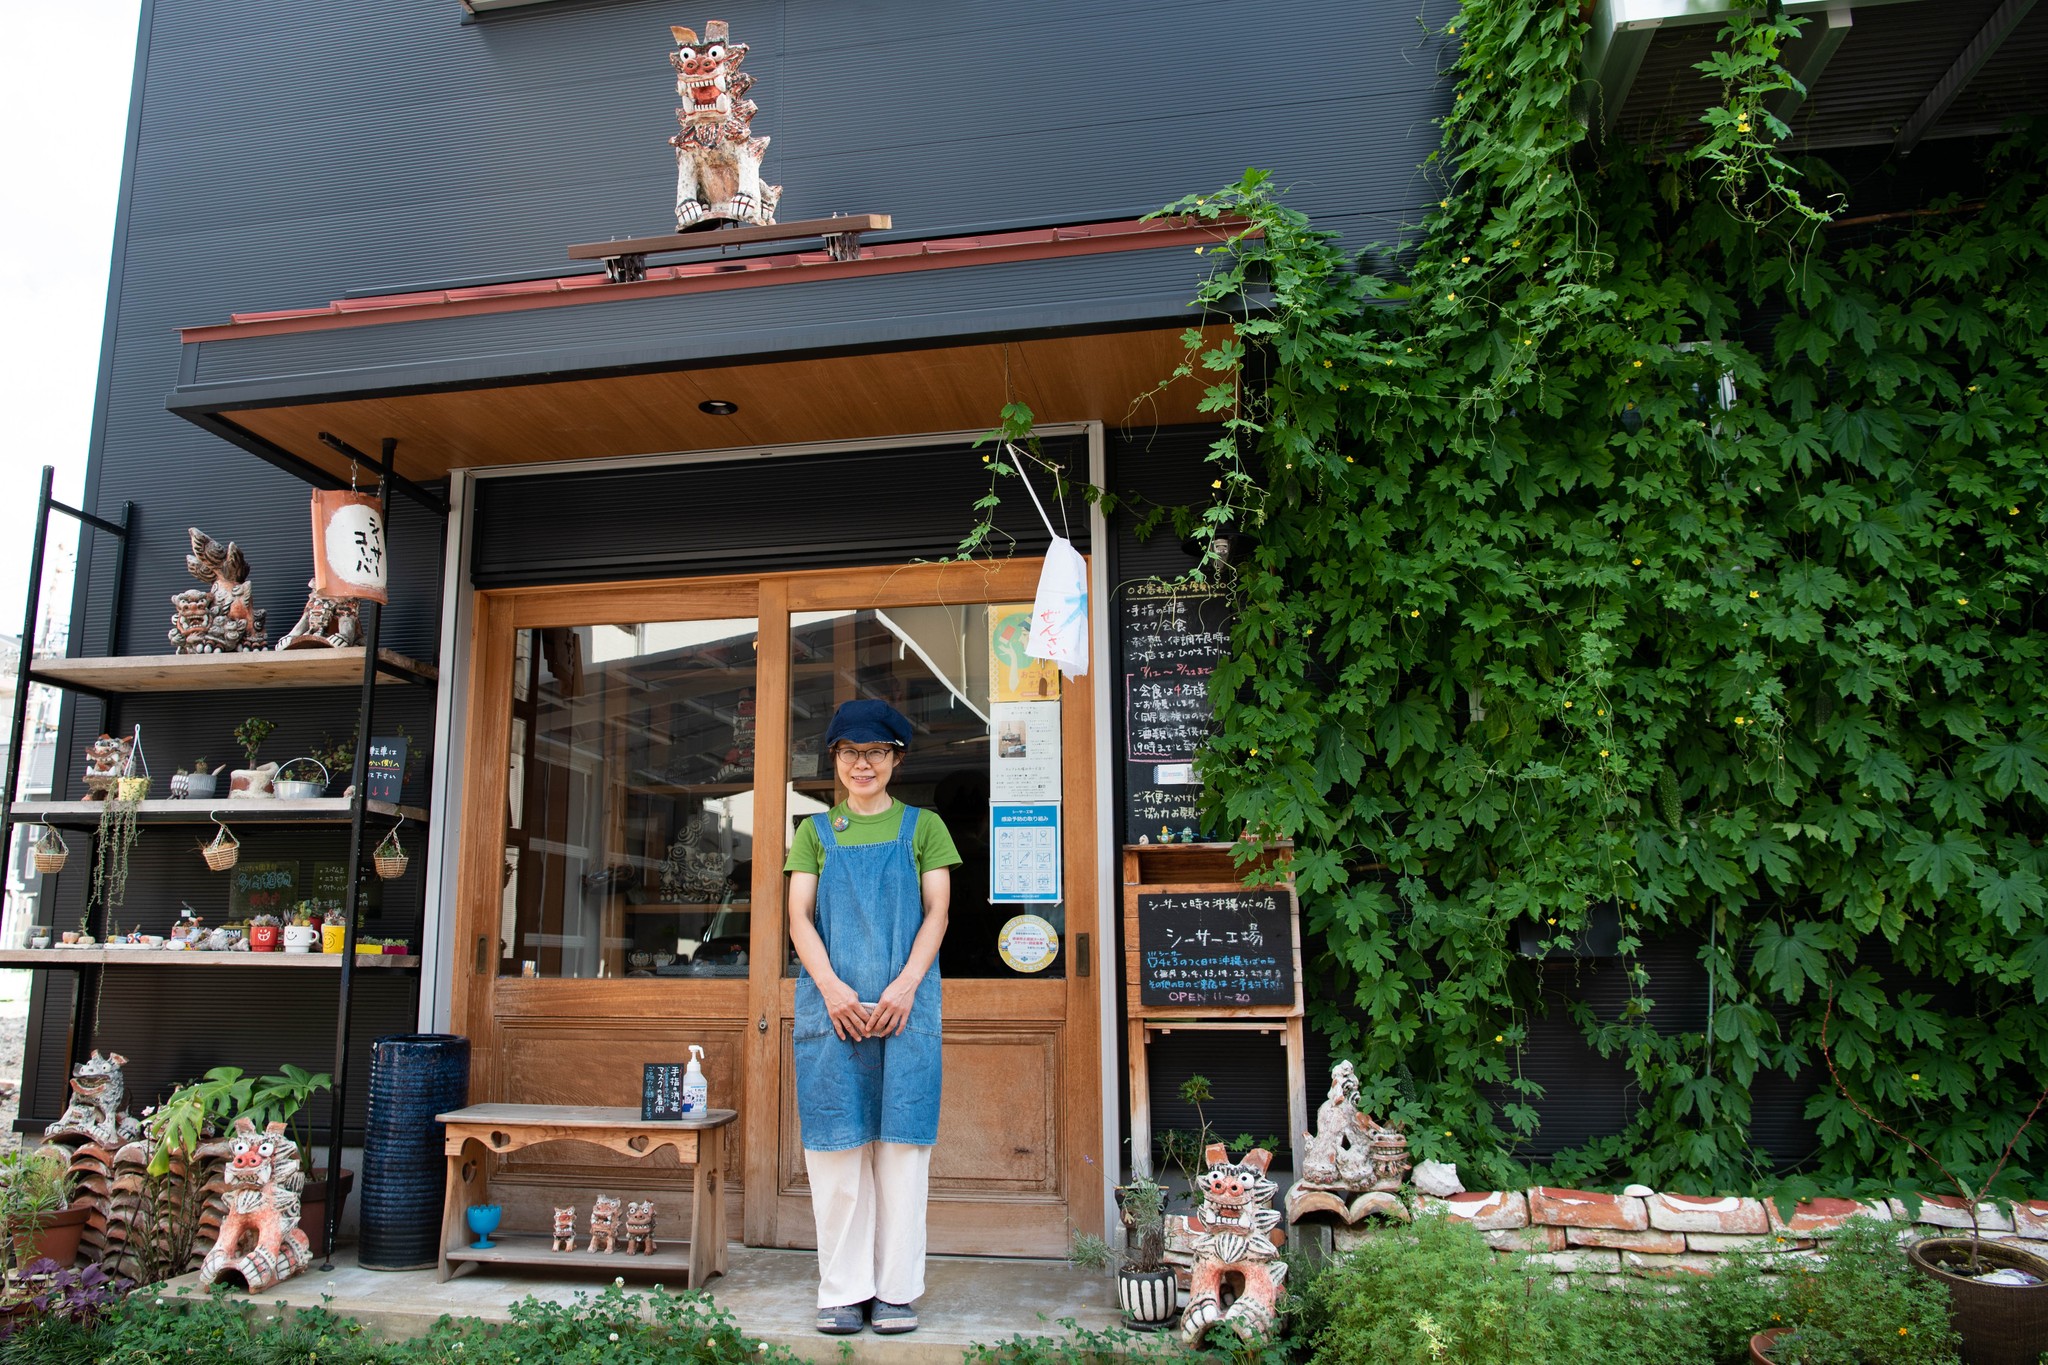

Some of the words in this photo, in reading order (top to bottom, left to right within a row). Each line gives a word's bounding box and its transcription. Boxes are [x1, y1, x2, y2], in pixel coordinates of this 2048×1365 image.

[354, 531, 372, 574] コーバ
[369, 517, 382, 577] シーサー
[1040, 609, 1067, 656] ぜんざい
[1166, 924, 1264, 948] シーサー工場
[1168, 991, 1205, 1002] OPEN
